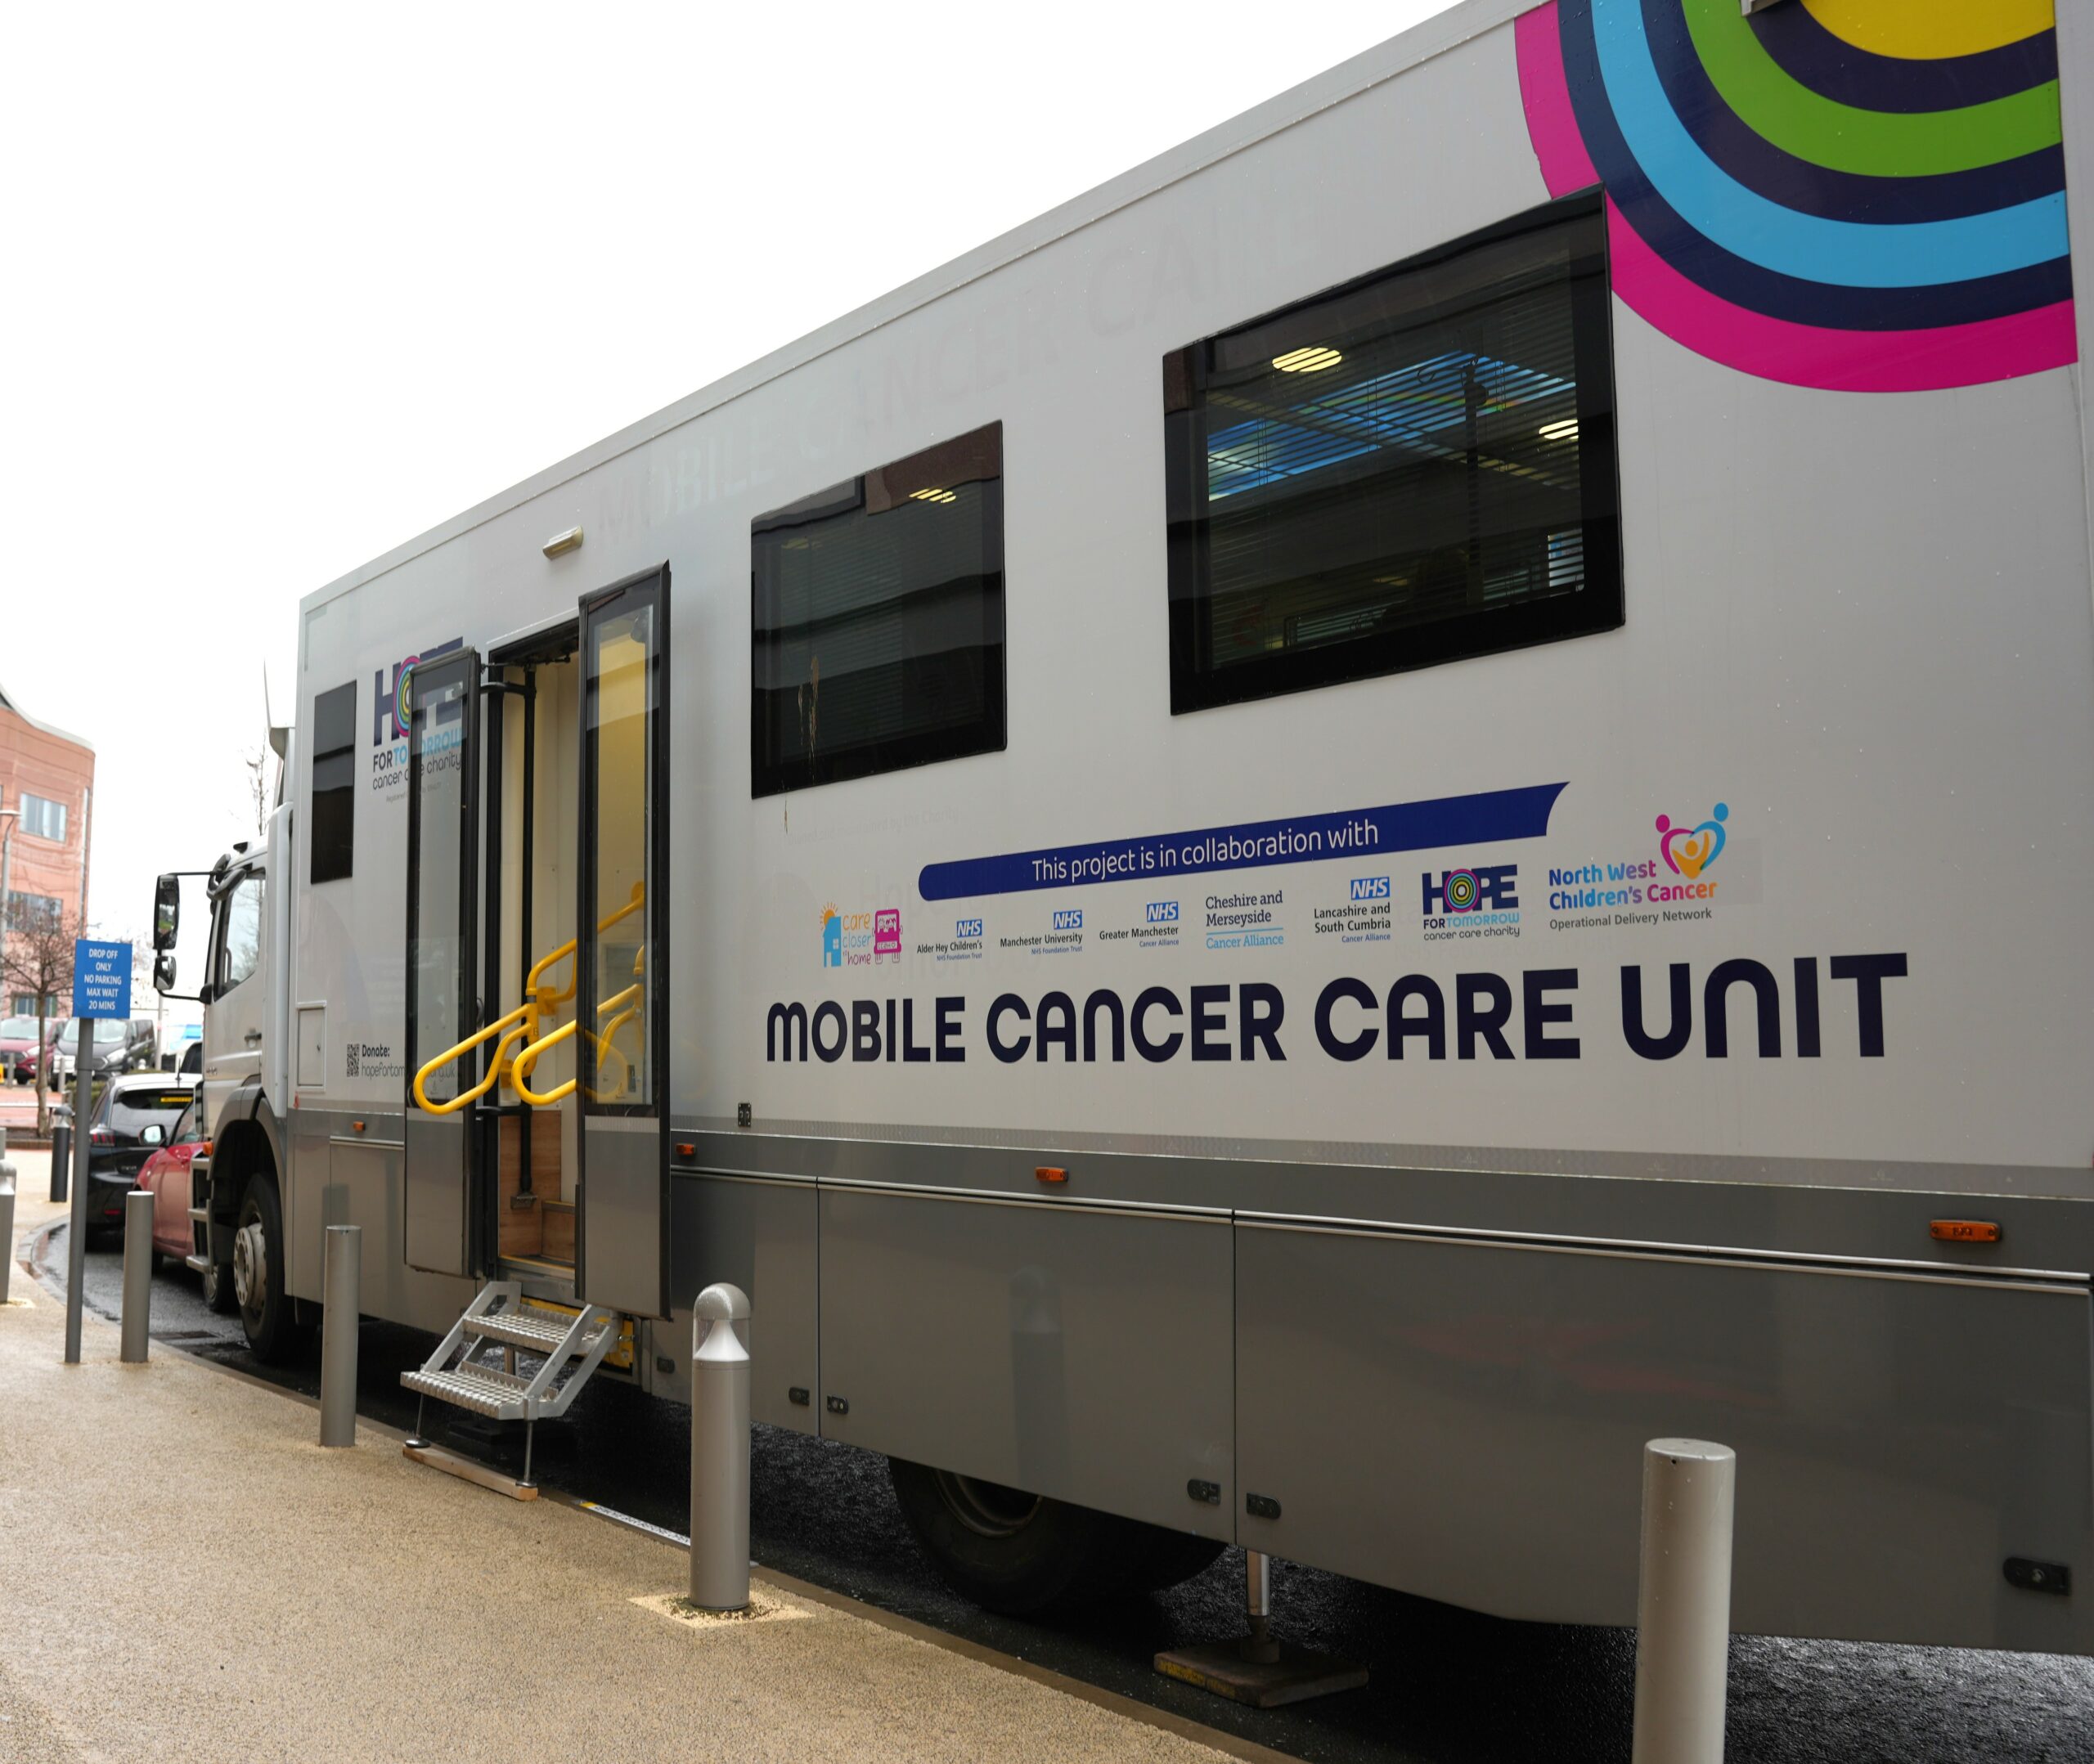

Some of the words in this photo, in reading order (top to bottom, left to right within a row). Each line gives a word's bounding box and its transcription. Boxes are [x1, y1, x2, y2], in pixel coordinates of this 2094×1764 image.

[373, 771, 402, 790] cancer
[405, 761, 424, 781] ce
[427, 752, 461, 775] charity
[1032, 859, 1067, 882] This
[1072, 851, 1135, 883] project
[1141, 846, 1155, 870] is
[1160, 844, 1177, 868] in
[1181, 828, 1322, 865] collaboration
[1328, 819, 1378, 849] with
[1549, 864, 1602, 886] North
[1608, 860, 1656, 880] West
[1351, 878, 1388, 900] NHS
[1422, 864, 1519, 915] HOPE
[1549, 886, 1642, 910] Children's
[1647, 882, 1718, 903] Cancer
[1206, 892, 1257, 909] Cheshire
[1260, 890, 1283, 904] and
[1147, 904, 1177, 921] NHS
[1206, 909, 1272, 927] Merseyside
[1314, 904, 1368, 919] Lancashire
[1371, 902, 1391, 915] and
[843, 913, 871, 931] care
[1054, 912, 1081, 929] NHS
[1314, 921, 1344, 934] South
[1347, 918, 1391, 931] Cumbria
[1549, 915, 1611, 931] Operational
[1615, 912, 1659, 926] Delivery
[1662, 908, 1712, 922] Network
[957, 921, 982, 936] NHS
[1099, 929, 1129, 940] Greater
[1131, 926, 1179, 938] Manchester
[1423, 931, 1457, 941] cancer
[1459, 928, 1481, 939] care
[1484, 926, 1521, 938] charity
[843, 932, 872, 948] closer
[1000, 937, 1042, 948] Manchester
[1045, 932, 1083, 945] University
[1158, 938, 1179, 947] Alliance
[1206, 936, 1241, 949] Cancer
[1242, 933, 1283, 948] Alliance
[1341, 935, 1363, 943] Cancer
[1365, 932, 1391, 942] Alliance
[88, 948, 106, 958] DROP
[106, 949, 118, 959] OFF
[917, 944, 934, 954] Alder
[936, 944, 948, 954] Hey
[950, 939, 982, 951] Children's
[1042, 946, 1070, 954] Foundation
[847, 951, 871, 966] home
[96, 962, 111, 972] ONLY
[84, 974, 94, 984] NO
[95, 975, 122, 985] PARKING
[87, 987, 101, 997] MAX
[101, 988, 119, 998] WAIT
[88, 1000, 97, 1010] 20
[99, 1001, 115, 1010] MINS
[767, 996, 965, 1062] MOBILE
[986, 982, 1287, 1063] CANCER
[1314, 967, 1580, 1062] CARE
[1620, 953, 1908, 1061] UNIT
[362, 1043, 389, 1057] Donate:
